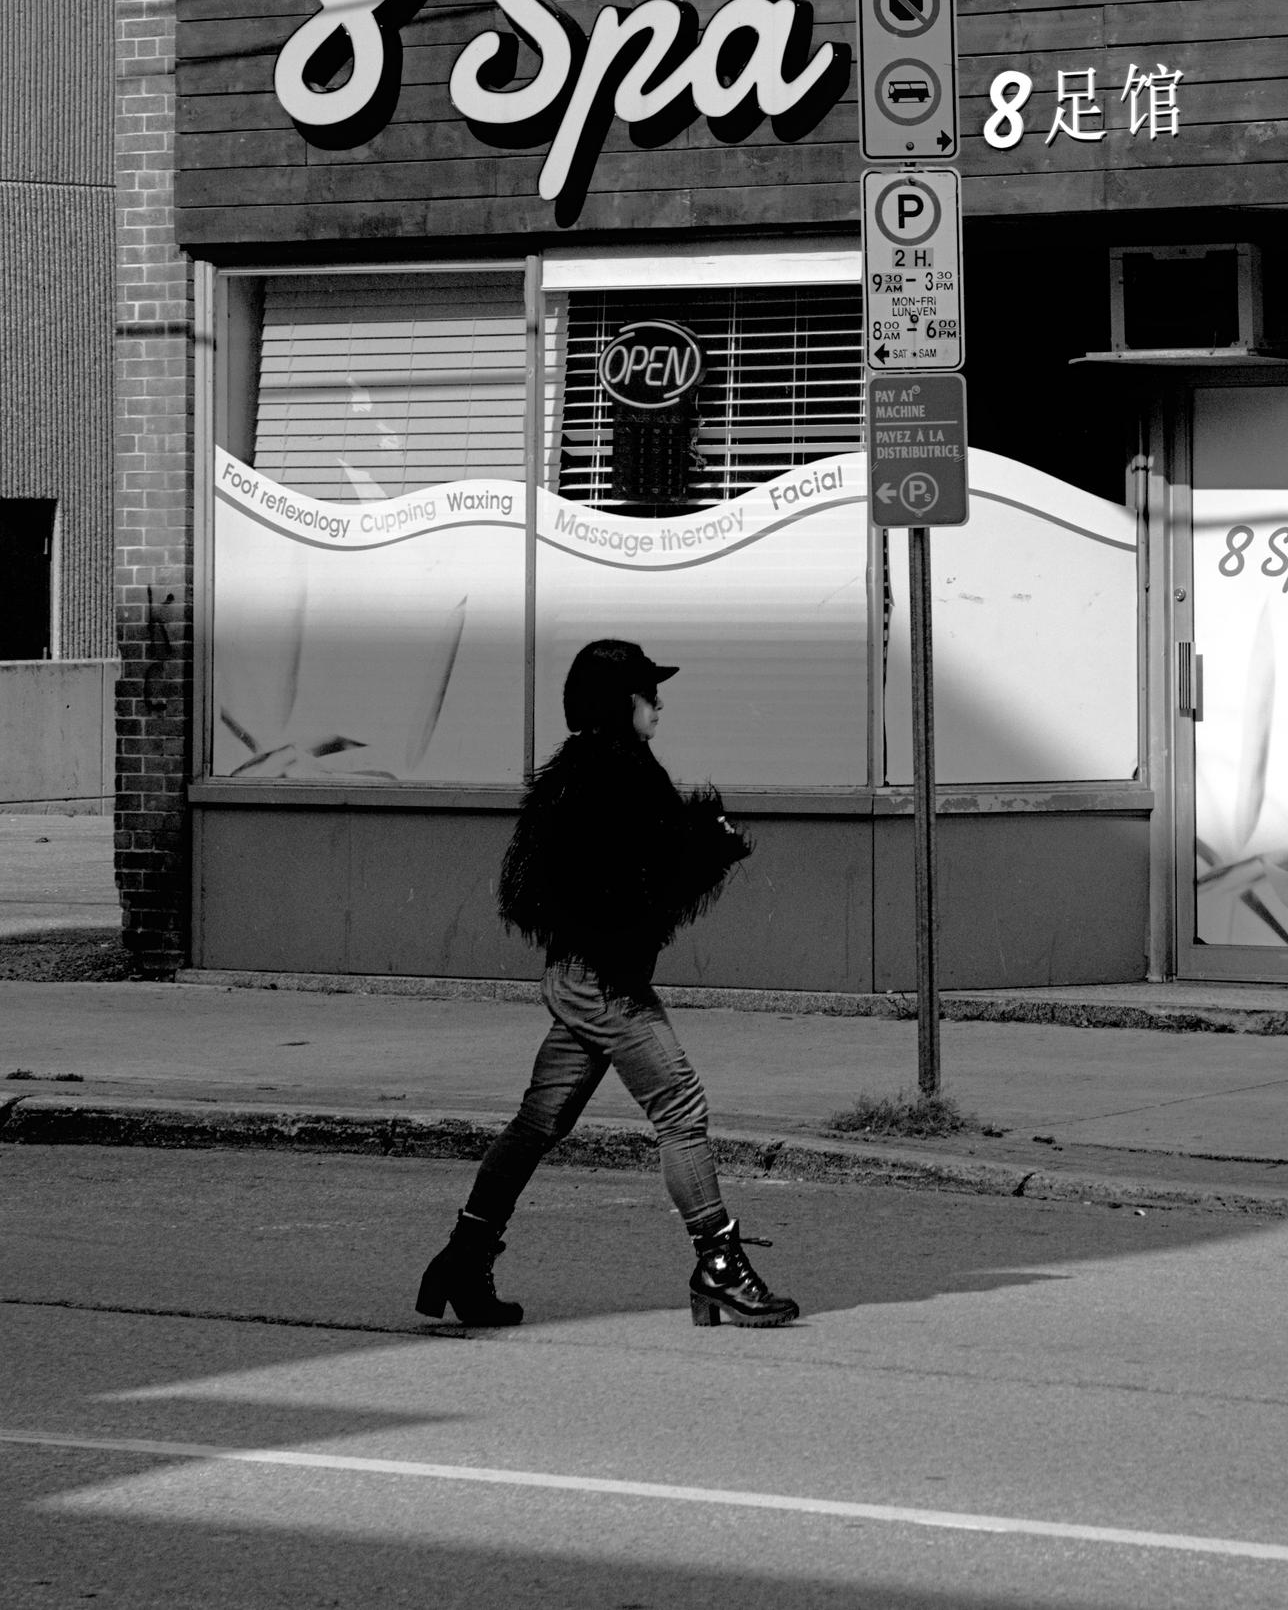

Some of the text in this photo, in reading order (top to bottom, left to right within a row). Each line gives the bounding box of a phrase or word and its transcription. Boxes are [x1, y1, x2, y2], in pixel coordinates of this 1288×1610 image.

[895, 250, 906, 267] 2
[872, 273, 883, 292] 9
[885, 284, 903, 293] AM
[925, 272, 934, 291] 3
[936, 282, 954, 291] PM
[892, 307, 937, 317] LUN-VEN
[872, 321, 882, 340] 8
[883, 331, 901, 340] AM
[926, 320, 937, 339] 6
[938, 330, 957, 339] PM
[892, 348, 937, 359] SAT SAM
[605, 345, 691, 386] OPEN
[875, 389, 914, 403] PAY AT
[876, 405, 926, 418] MACHINE
[876, 430, 911, 443] PAYEZ
[929, 430, 944, 442] LA
[877, 445, 959, 459] DISTRIBUTRICE
[769, 465, 843, 510] Facial
[222, 462, 350, 538] Foot reflexology
[360, 490, 513, 534] Cupping Waxing
[554, 508, 744, 557] Massage therapy
[1218, 525, 1254, 577] 8
